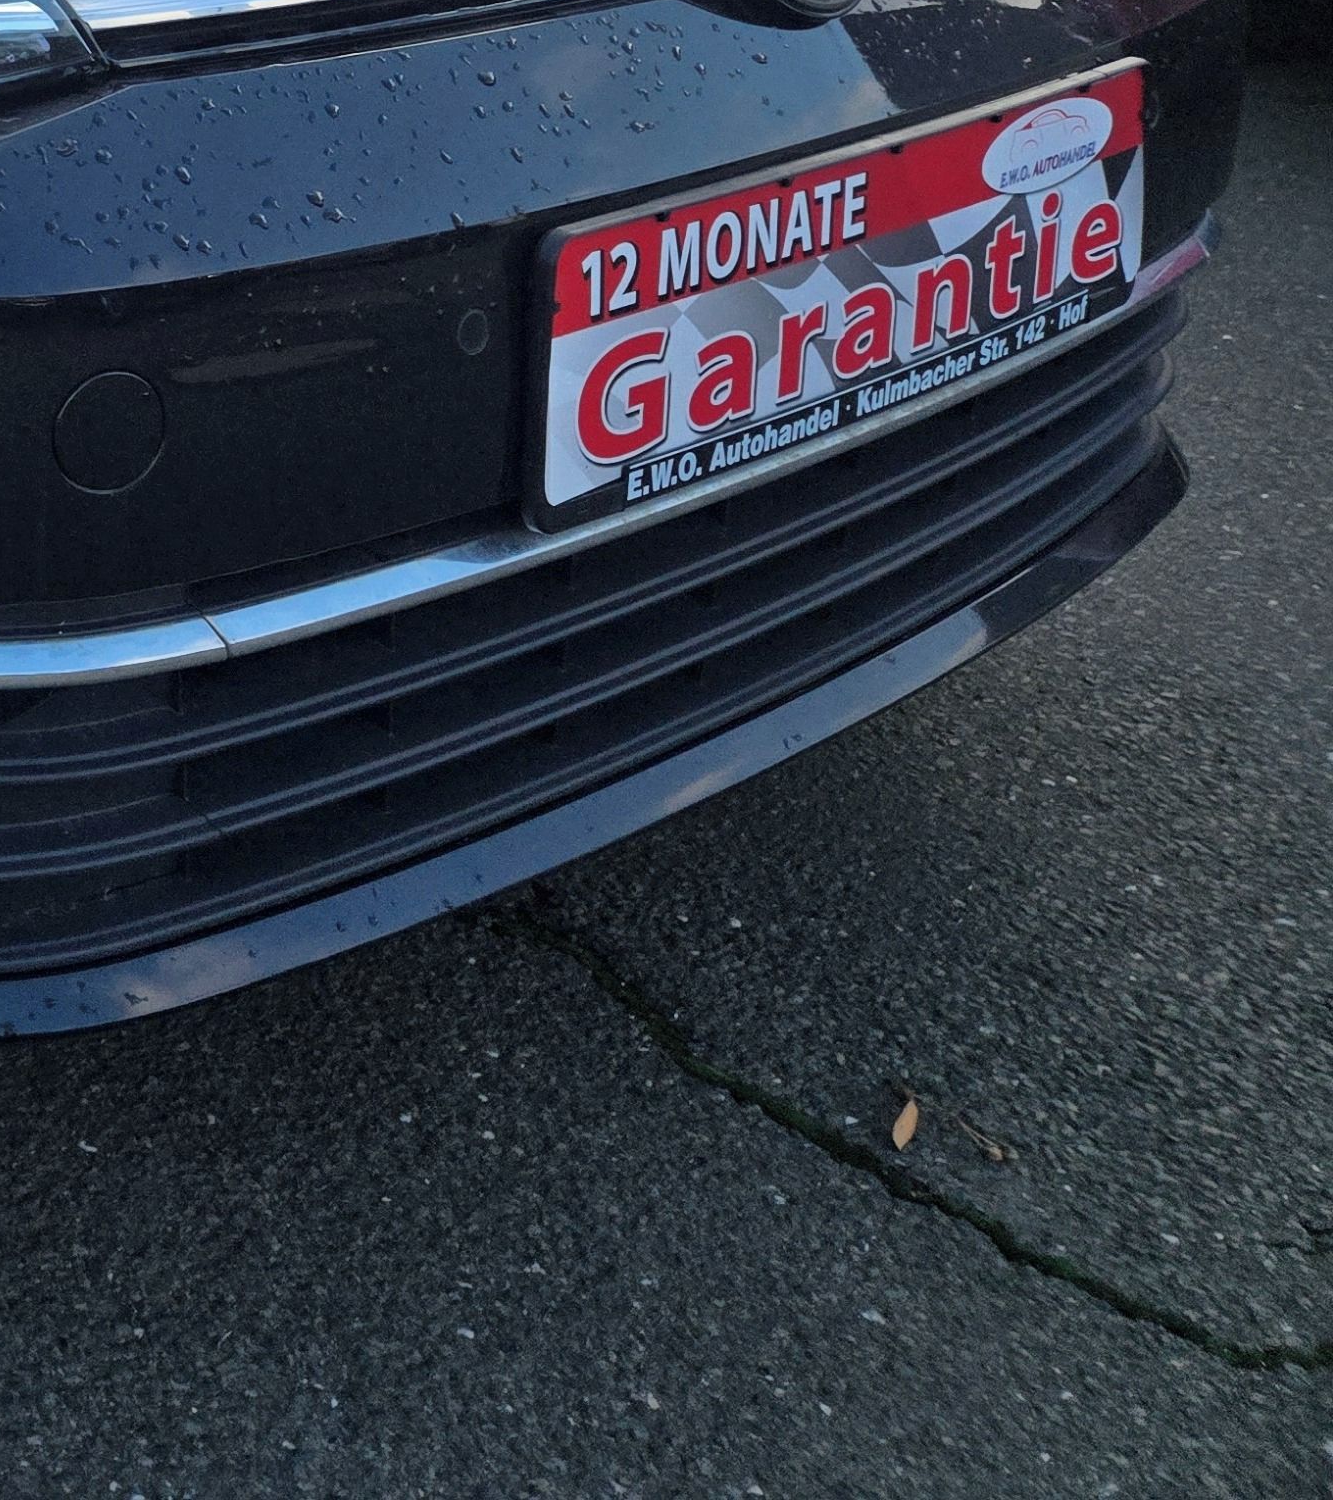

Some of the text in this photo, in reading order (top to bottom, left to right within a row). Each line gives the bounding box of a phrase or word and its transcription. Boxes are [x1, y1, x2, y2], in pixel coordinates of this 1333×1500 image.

[581, 171, 868, 317] 12 MONATE
[1000, 141, 1096, 189] E.W.O. AUTOHANDEL
[576, 191, 1122, 465] Garantie
[627, 294, 1089, 501] E.W.O. Autohandel Kulmbacher Str. 142 Hof
